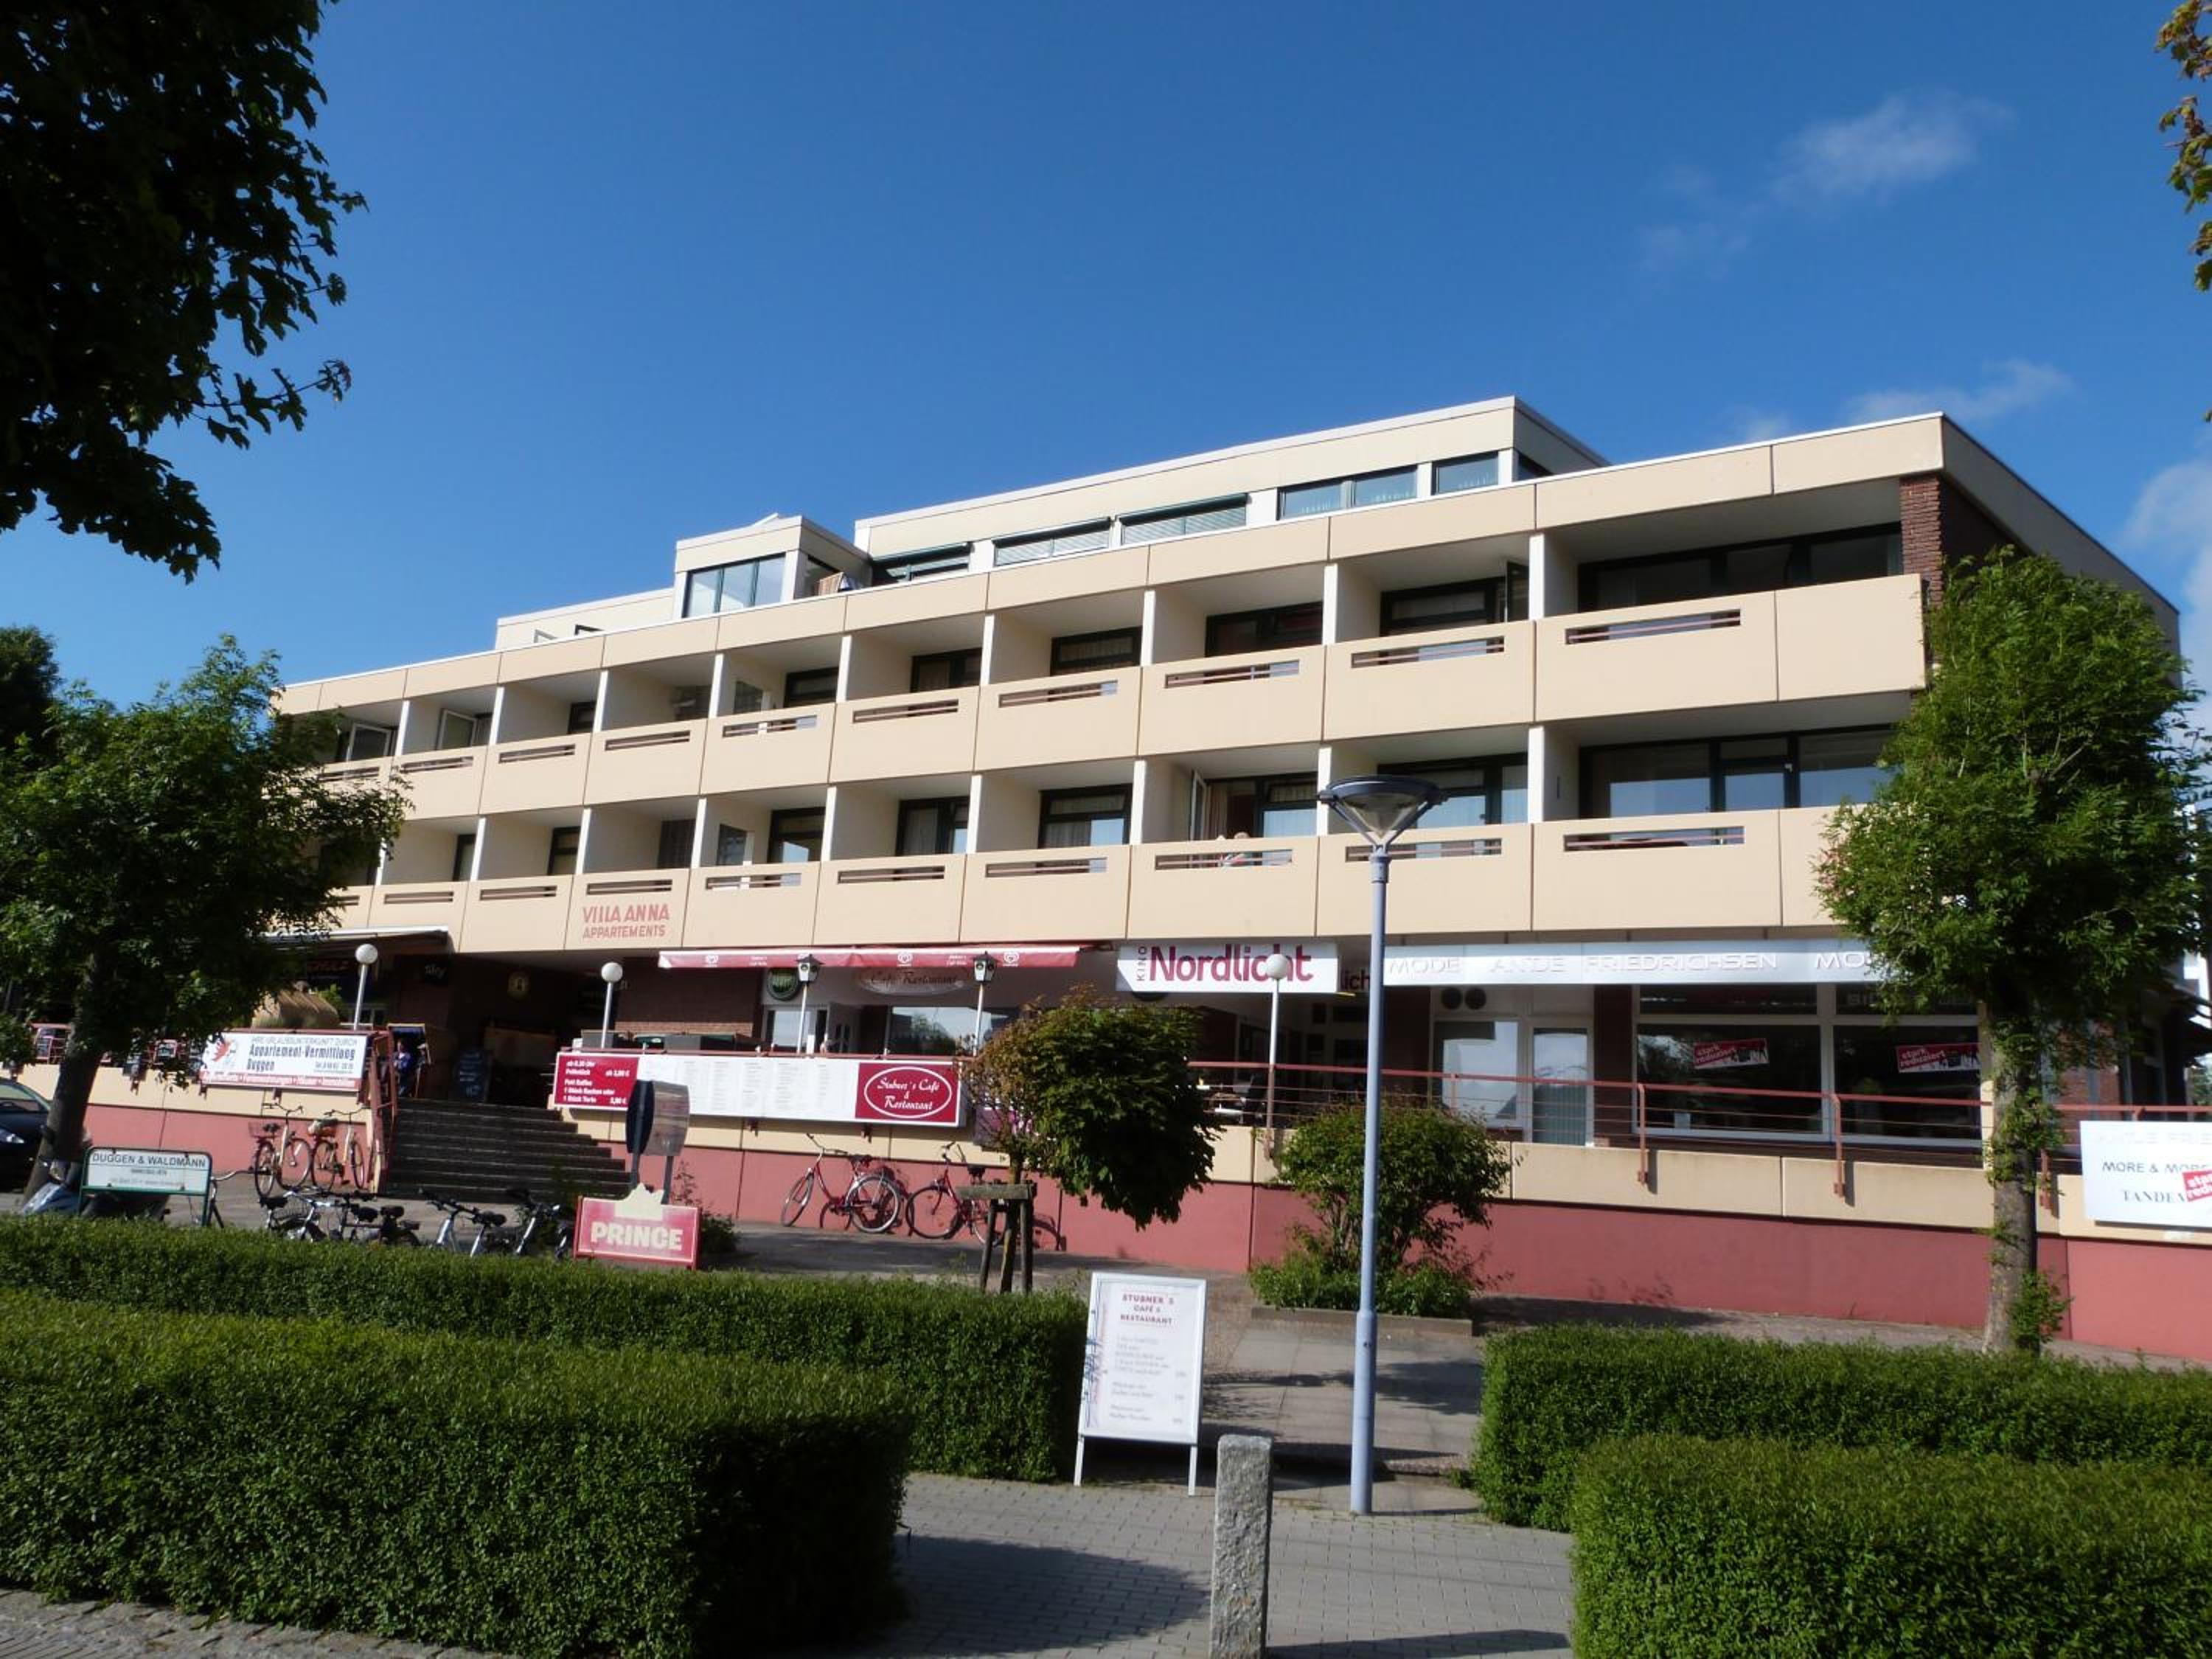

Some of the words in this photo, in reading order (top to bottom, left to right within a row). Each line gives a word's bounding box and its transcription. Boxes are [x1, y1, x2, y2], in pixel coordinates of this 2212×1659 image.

[582, 905, 621, 923] VILLA
[624, 903, 669, 922] ANNA
[582, 924, 666, 939] APPARTEMENTS
[1135, 945, 1147, 981] KINO
[1388, 956, 1461, 974] MODE
[1585, 953, 1778, 972] FRIEDRICHSEN
[1813, 951, 1868, 969] MO
[1340, 968, 1372, 991] lich
[918, 1078, 940, 1093] Café
[884, 1095, 933, 1110] Restaurant
[92, 1152, 135, 1164] DUGGEN
[138, 1154, 145, 1164] &
[147, 1155, 206, 1167] WALDMANN
[2101, 1161, 2145, 1173] MORE
[2149, 1164, 2159, 1174] &
[591, 1221, 684, 1251] PRINCE
[1120, 1313, 1172, 1325] RESTAURANT
